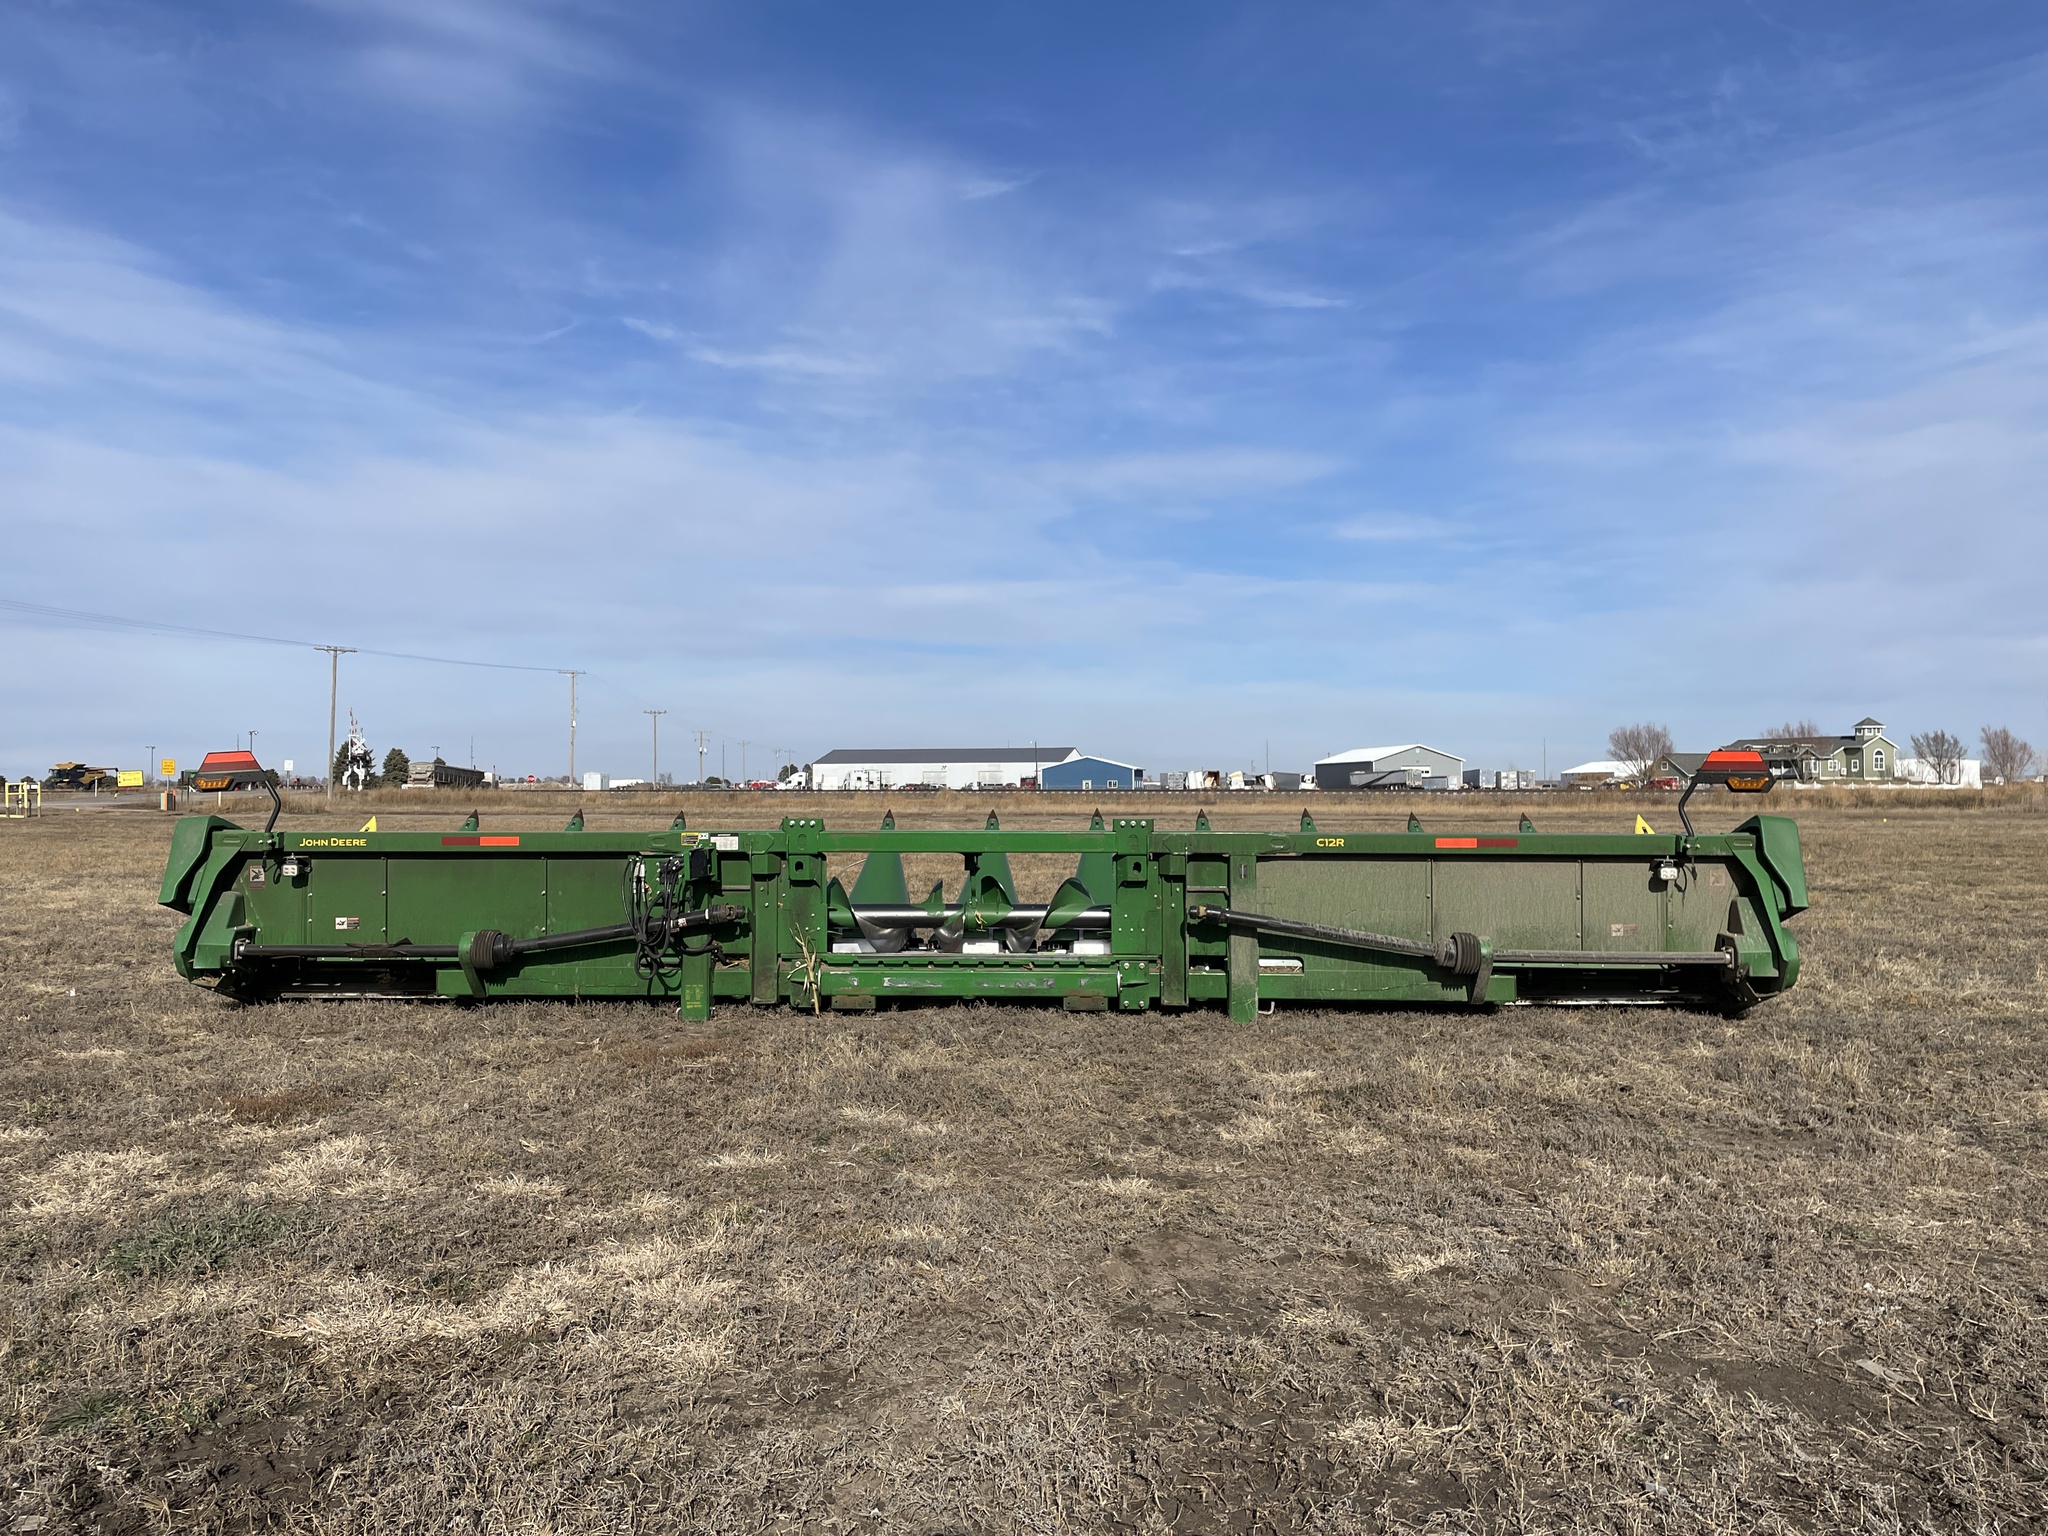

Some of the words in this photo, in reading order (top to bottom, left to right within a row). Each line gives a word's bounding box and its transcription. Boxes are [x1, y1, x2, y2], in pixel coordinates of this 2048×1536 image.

[299, 837, 329, 847] JOHN
[330, 837, 367, 847] DEERE
[1316, 838, 1345, 847] C12R
